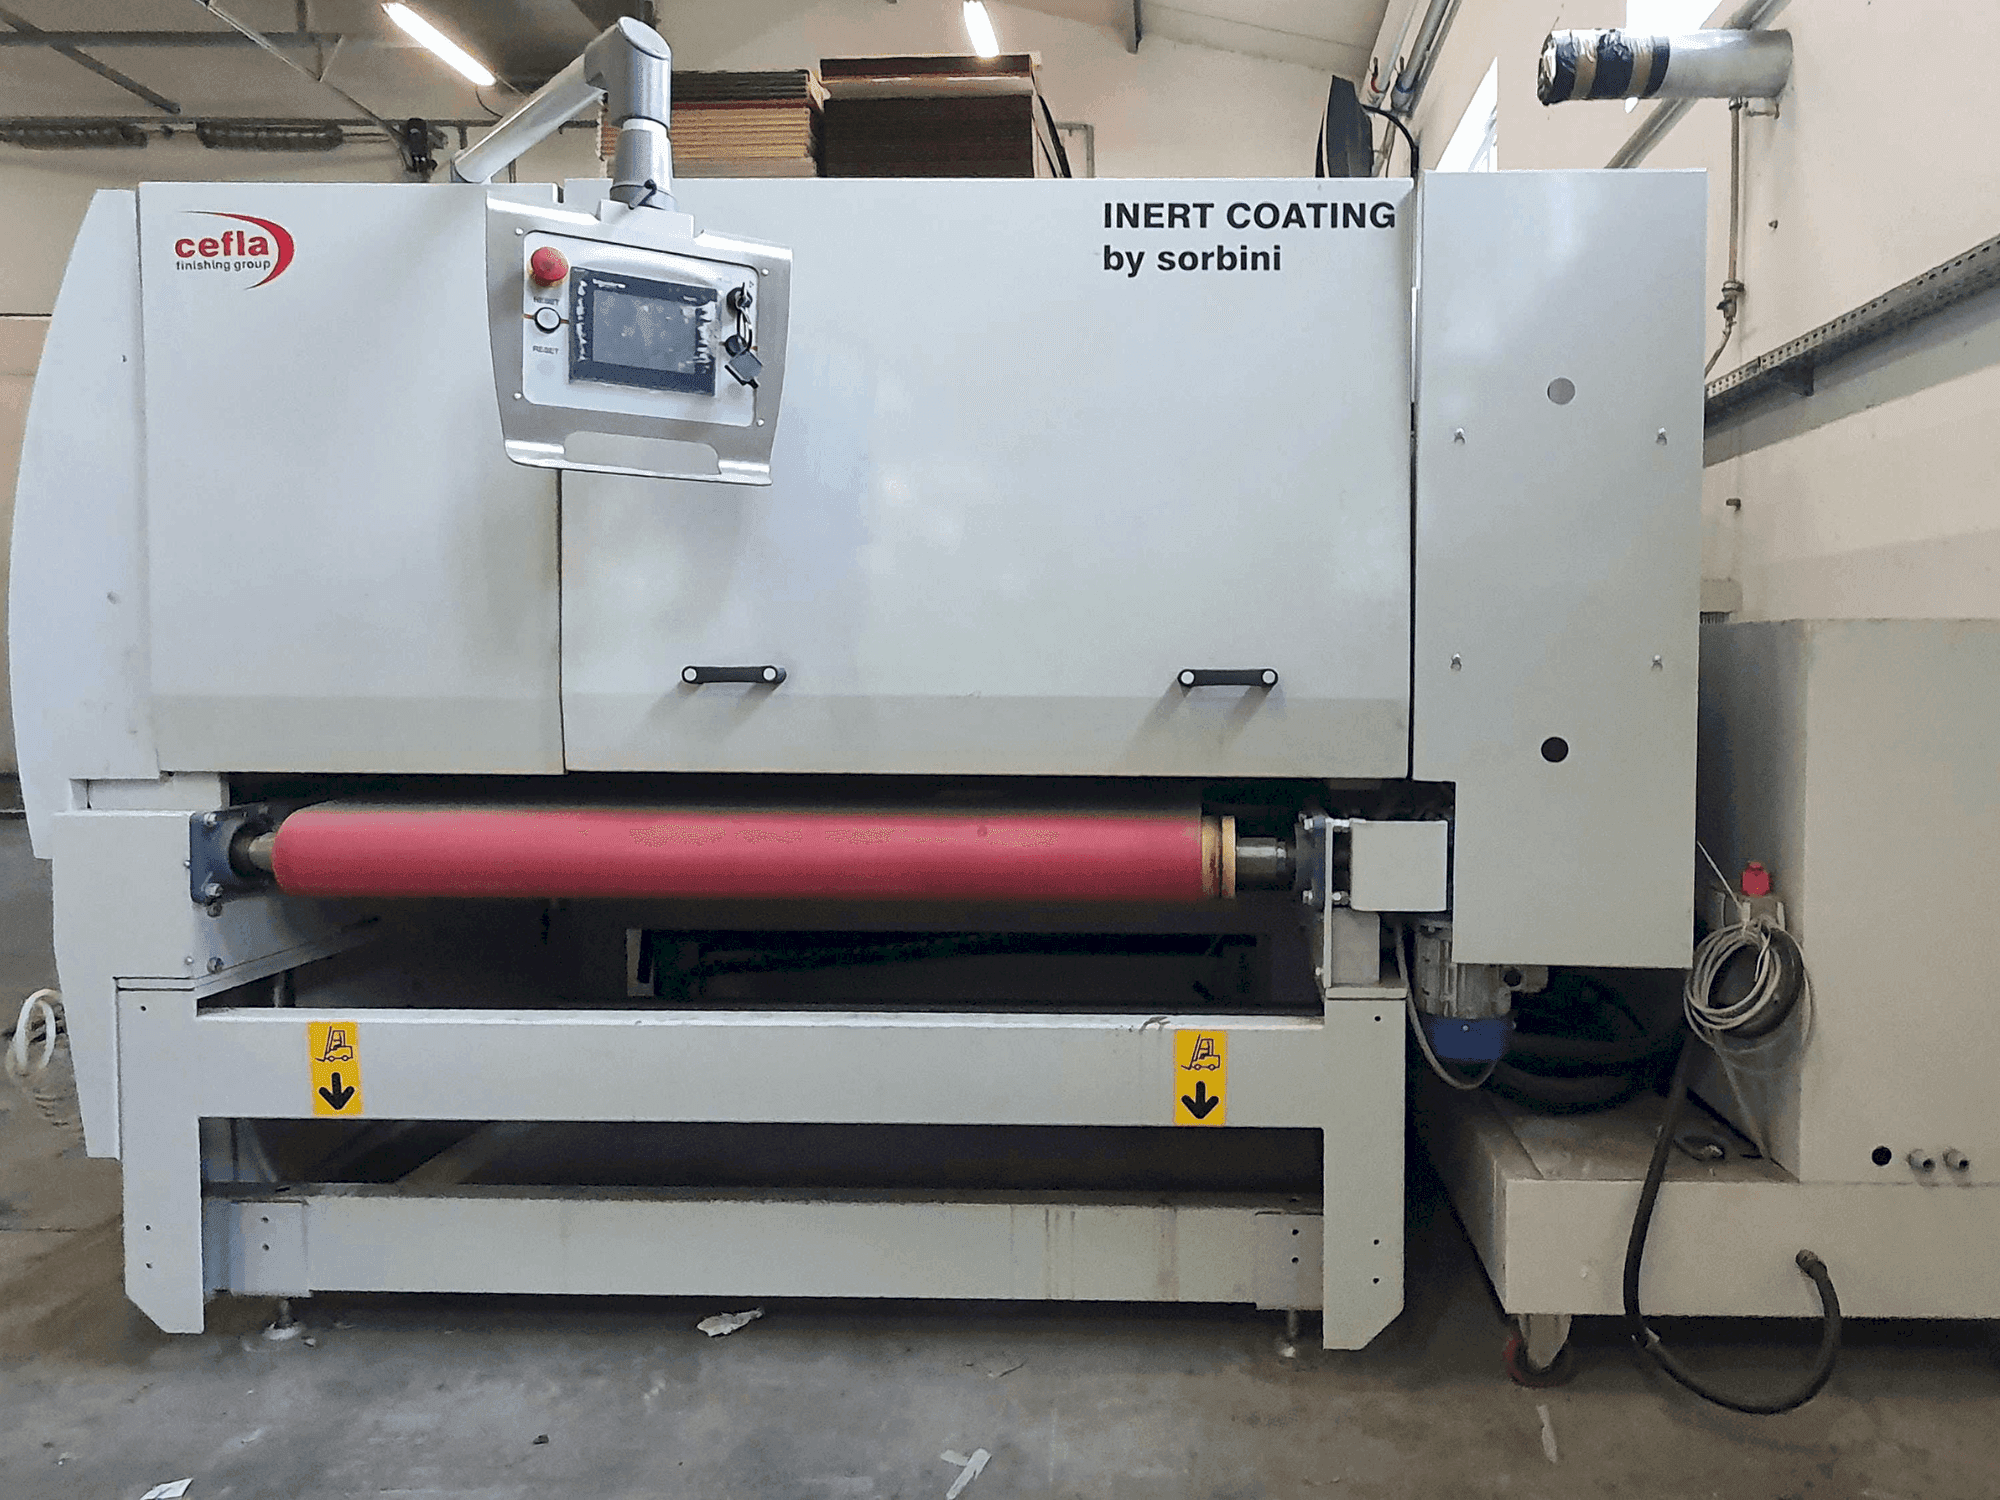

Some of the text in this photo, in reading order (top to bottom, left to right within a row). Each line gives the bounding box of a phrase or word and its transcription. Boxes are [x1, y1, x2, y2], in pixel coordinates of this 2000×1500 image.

[1104, 202, 1396, 229] INERT COATING
[174, 230, 269, 258] cefla
[176, 260, 271, 271] finishing group
[1103, 245, 1281, 278] by sorbini
